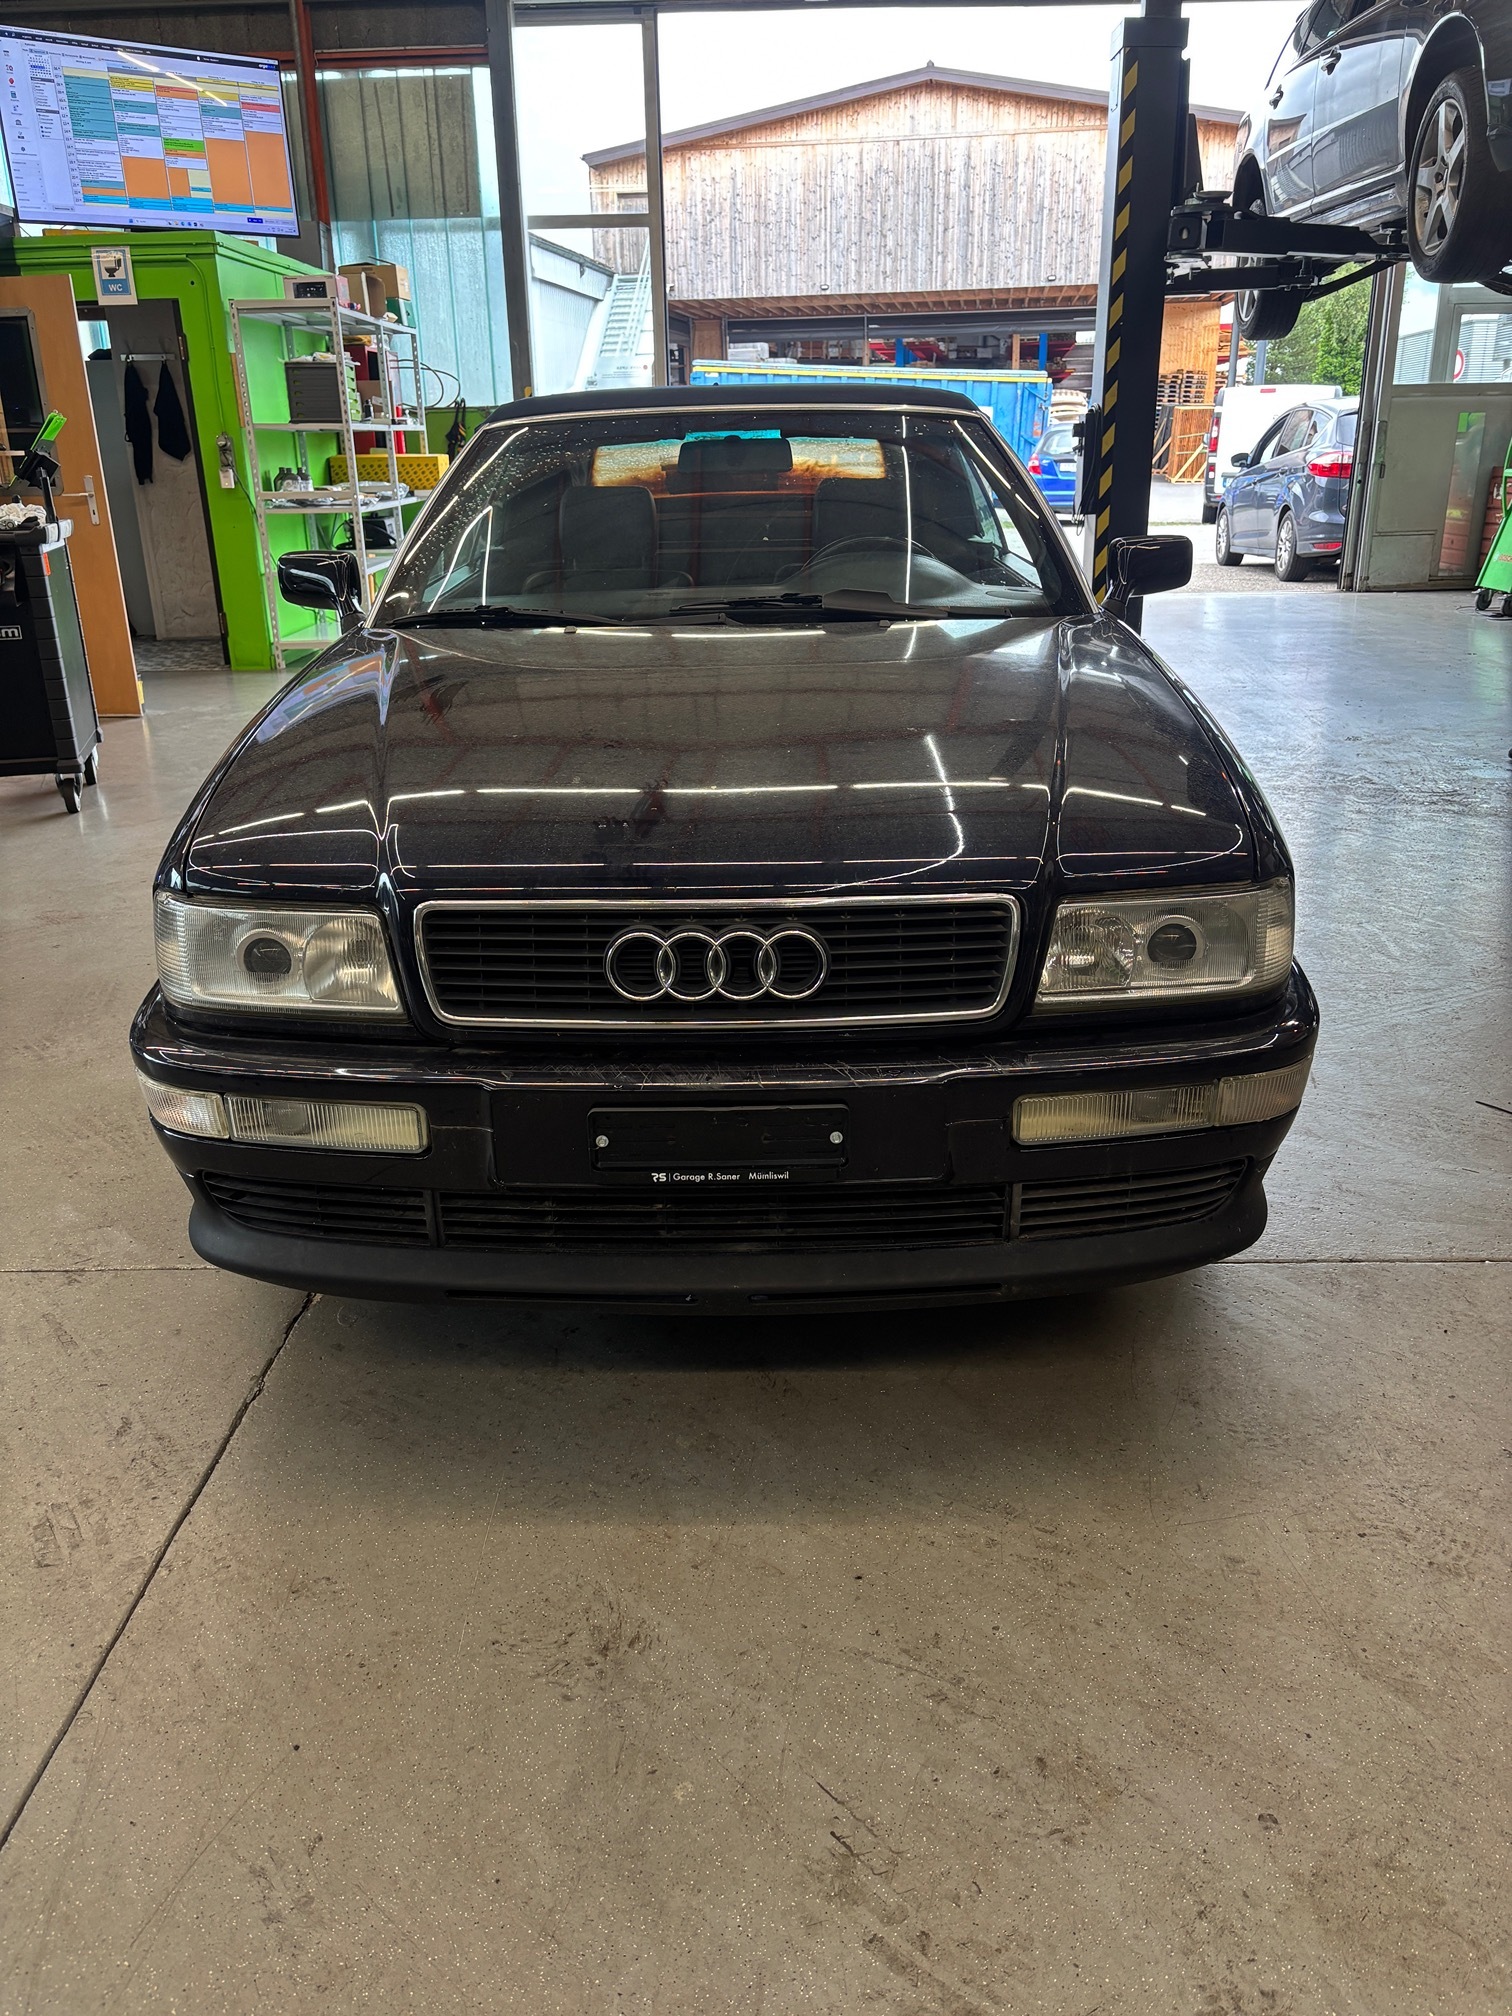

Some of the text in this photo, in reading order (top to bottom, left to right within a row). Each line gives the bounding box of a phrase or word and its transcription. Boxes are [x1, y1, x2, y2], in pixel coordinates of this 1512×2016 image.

[108, 283, 123, 292] WC
[0, 628, 19, 638] m
[672, 1172, 705, 1182] Garage
[708, 1172, 740, 1180] R.Saner
[748, 1170, 789, 1180] Mümliswil
